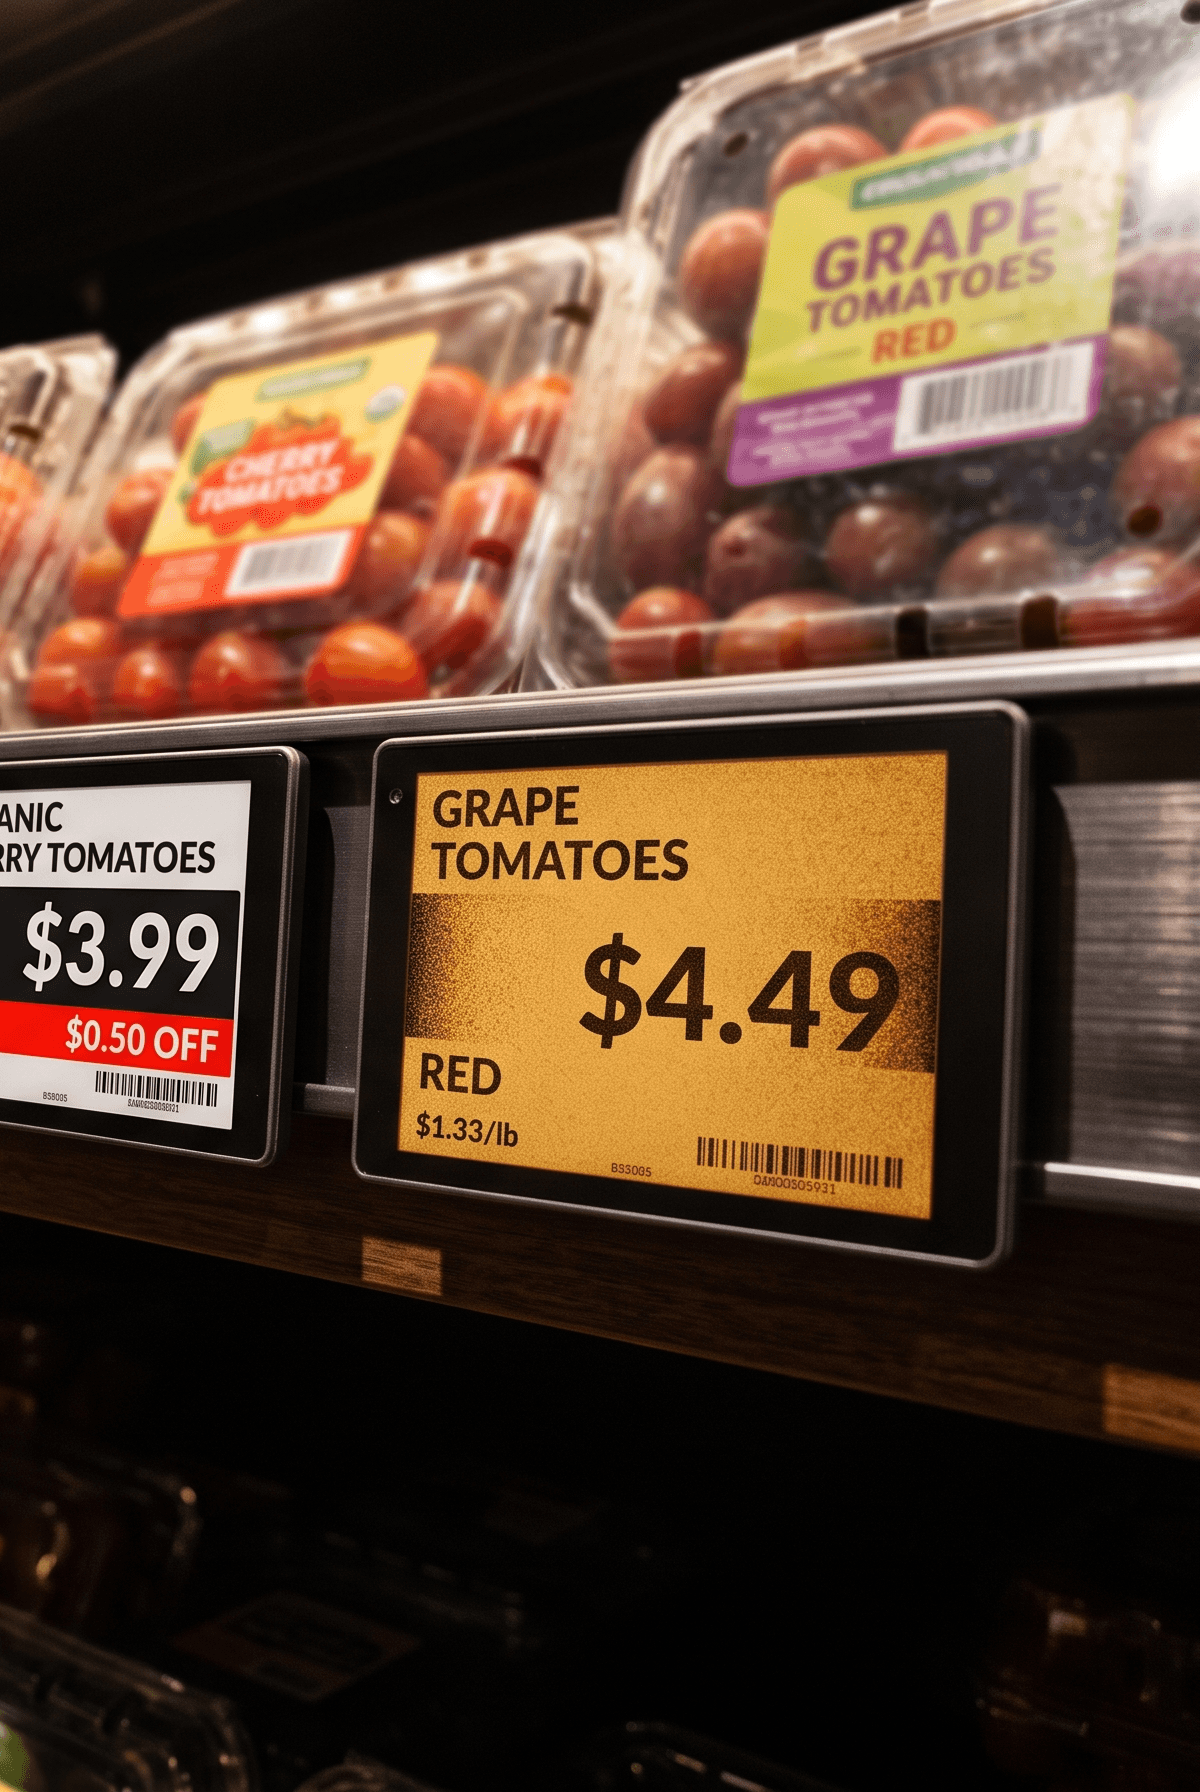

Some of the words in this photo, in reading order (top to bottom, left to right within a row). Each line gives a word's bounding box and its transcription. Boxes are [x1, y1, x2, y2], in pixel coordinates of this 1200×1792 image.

[813, 182, 1062, 292] GRAPE
[806, 247, 1056, 333] TOMATOES
[871, 317, 958, 365] RED
[224, 438, 341, 484] CHERRY
[198, 465, 345, 515] TOMATOES
[432, 785, 580, 829] GRAPE
[47, 840, 216, 875] TOMATOES
[431, 837, 689, 882] TOMATOES
[22, 900, 220, 993] $3.99
[578, 931, 901, 1053] $4.49
[65, 1013, 146, 1055] $0.50
[153, 1025, 219, 1064] OFF
[419, 1052, 502, 1096] RED
[414, 1110, 520, 1149] $1.33/lb
